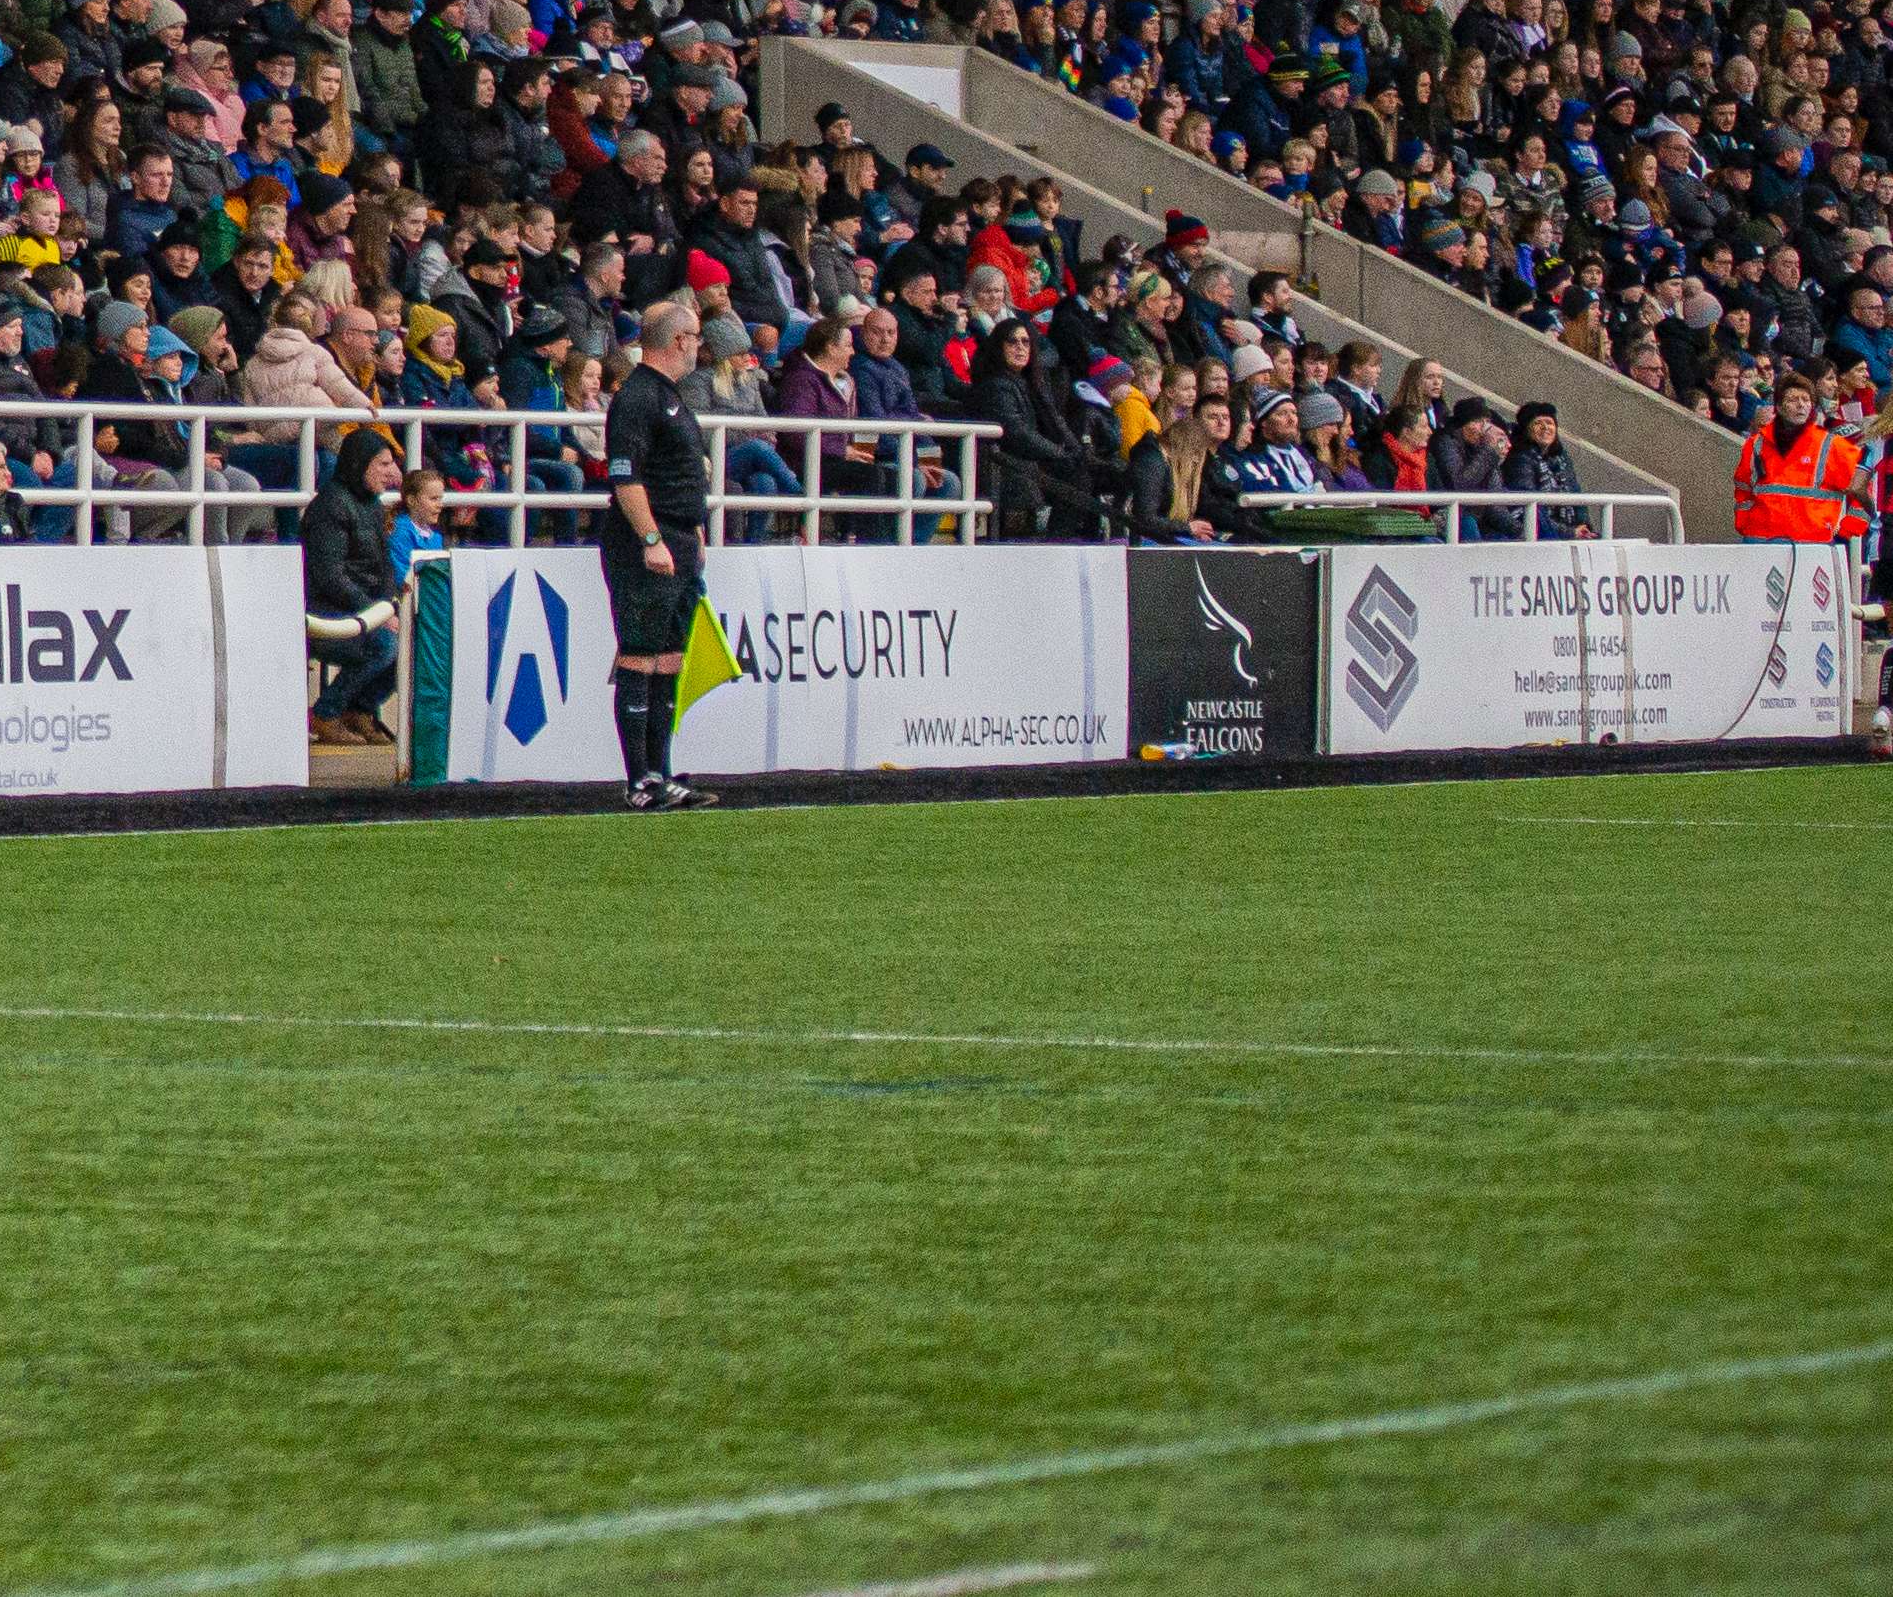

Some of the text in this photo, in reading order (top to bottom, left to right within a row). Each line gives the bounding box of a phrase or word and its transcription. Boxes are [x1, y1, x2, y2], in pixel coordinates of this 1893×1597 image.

[1470, 574, 1731, 617] THE SANDS GROUP U.K
[1553, 635, 1577, 658] 0800
[1599, 635, 1628, 657] 6454
[1187, 699, 1264, 719] NEWCASTLE
[904, 714, 1107, 747] WWW.ALPHA-SEC.CO.UK
[1186, 727, 1264, 753] FALCONS
